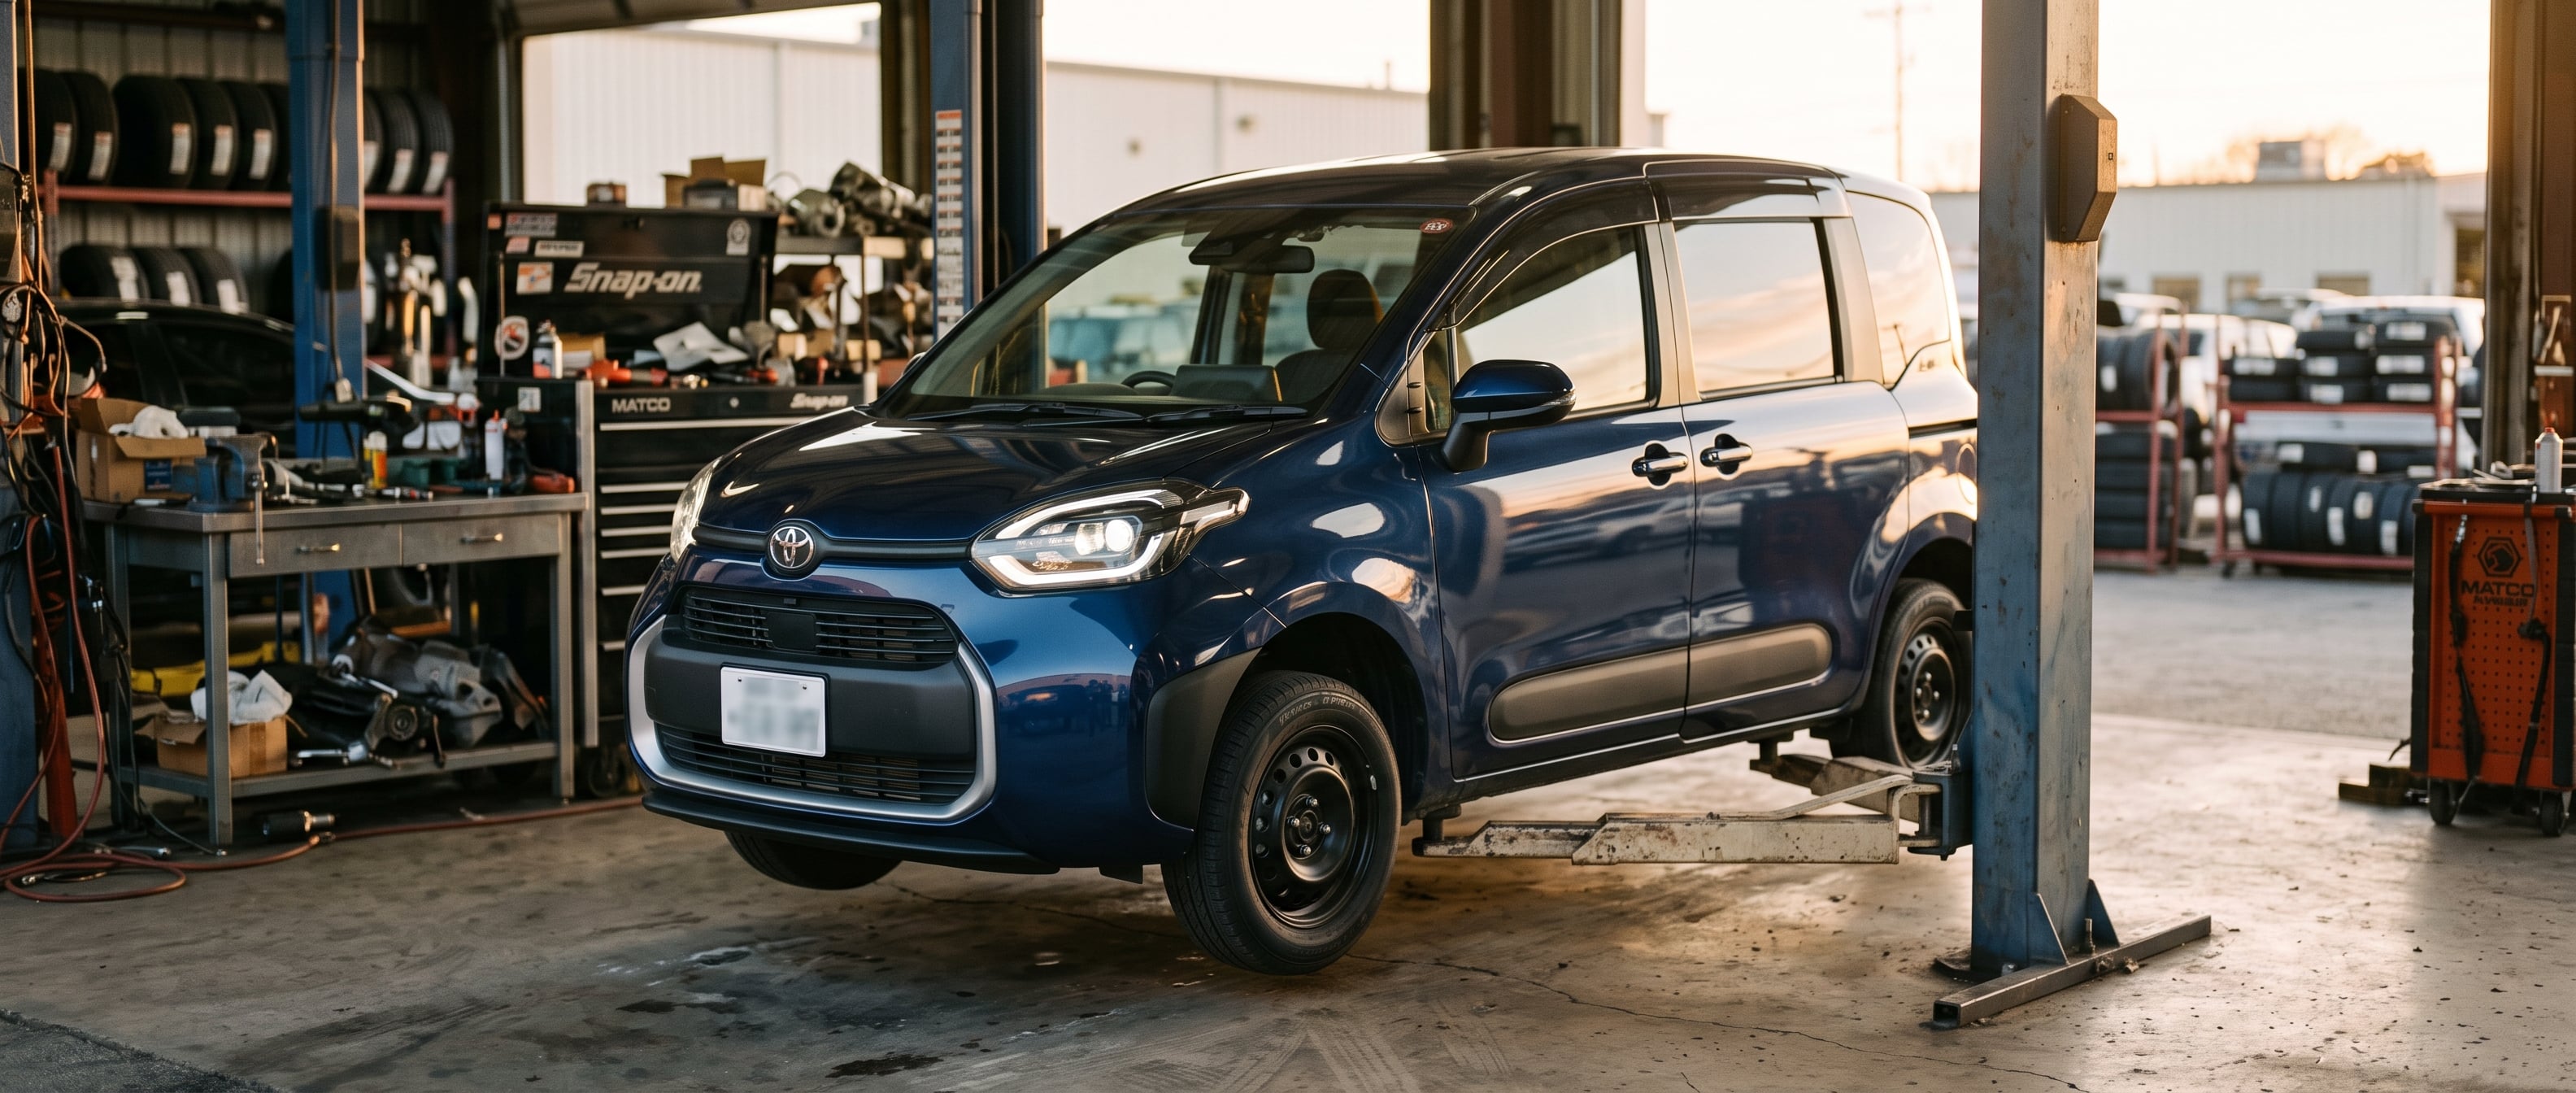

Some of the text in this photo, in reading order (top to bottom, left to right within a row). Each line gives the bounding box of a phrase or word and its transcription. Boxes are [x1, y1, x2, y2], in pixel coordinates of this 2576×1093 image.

[564, 262, 703, 299] Snap-on
[611, 398, 671, 413] MATCO
[790, 393, 848, 411] Snap-on
[2461, 581, 2535, 597] MATCO
